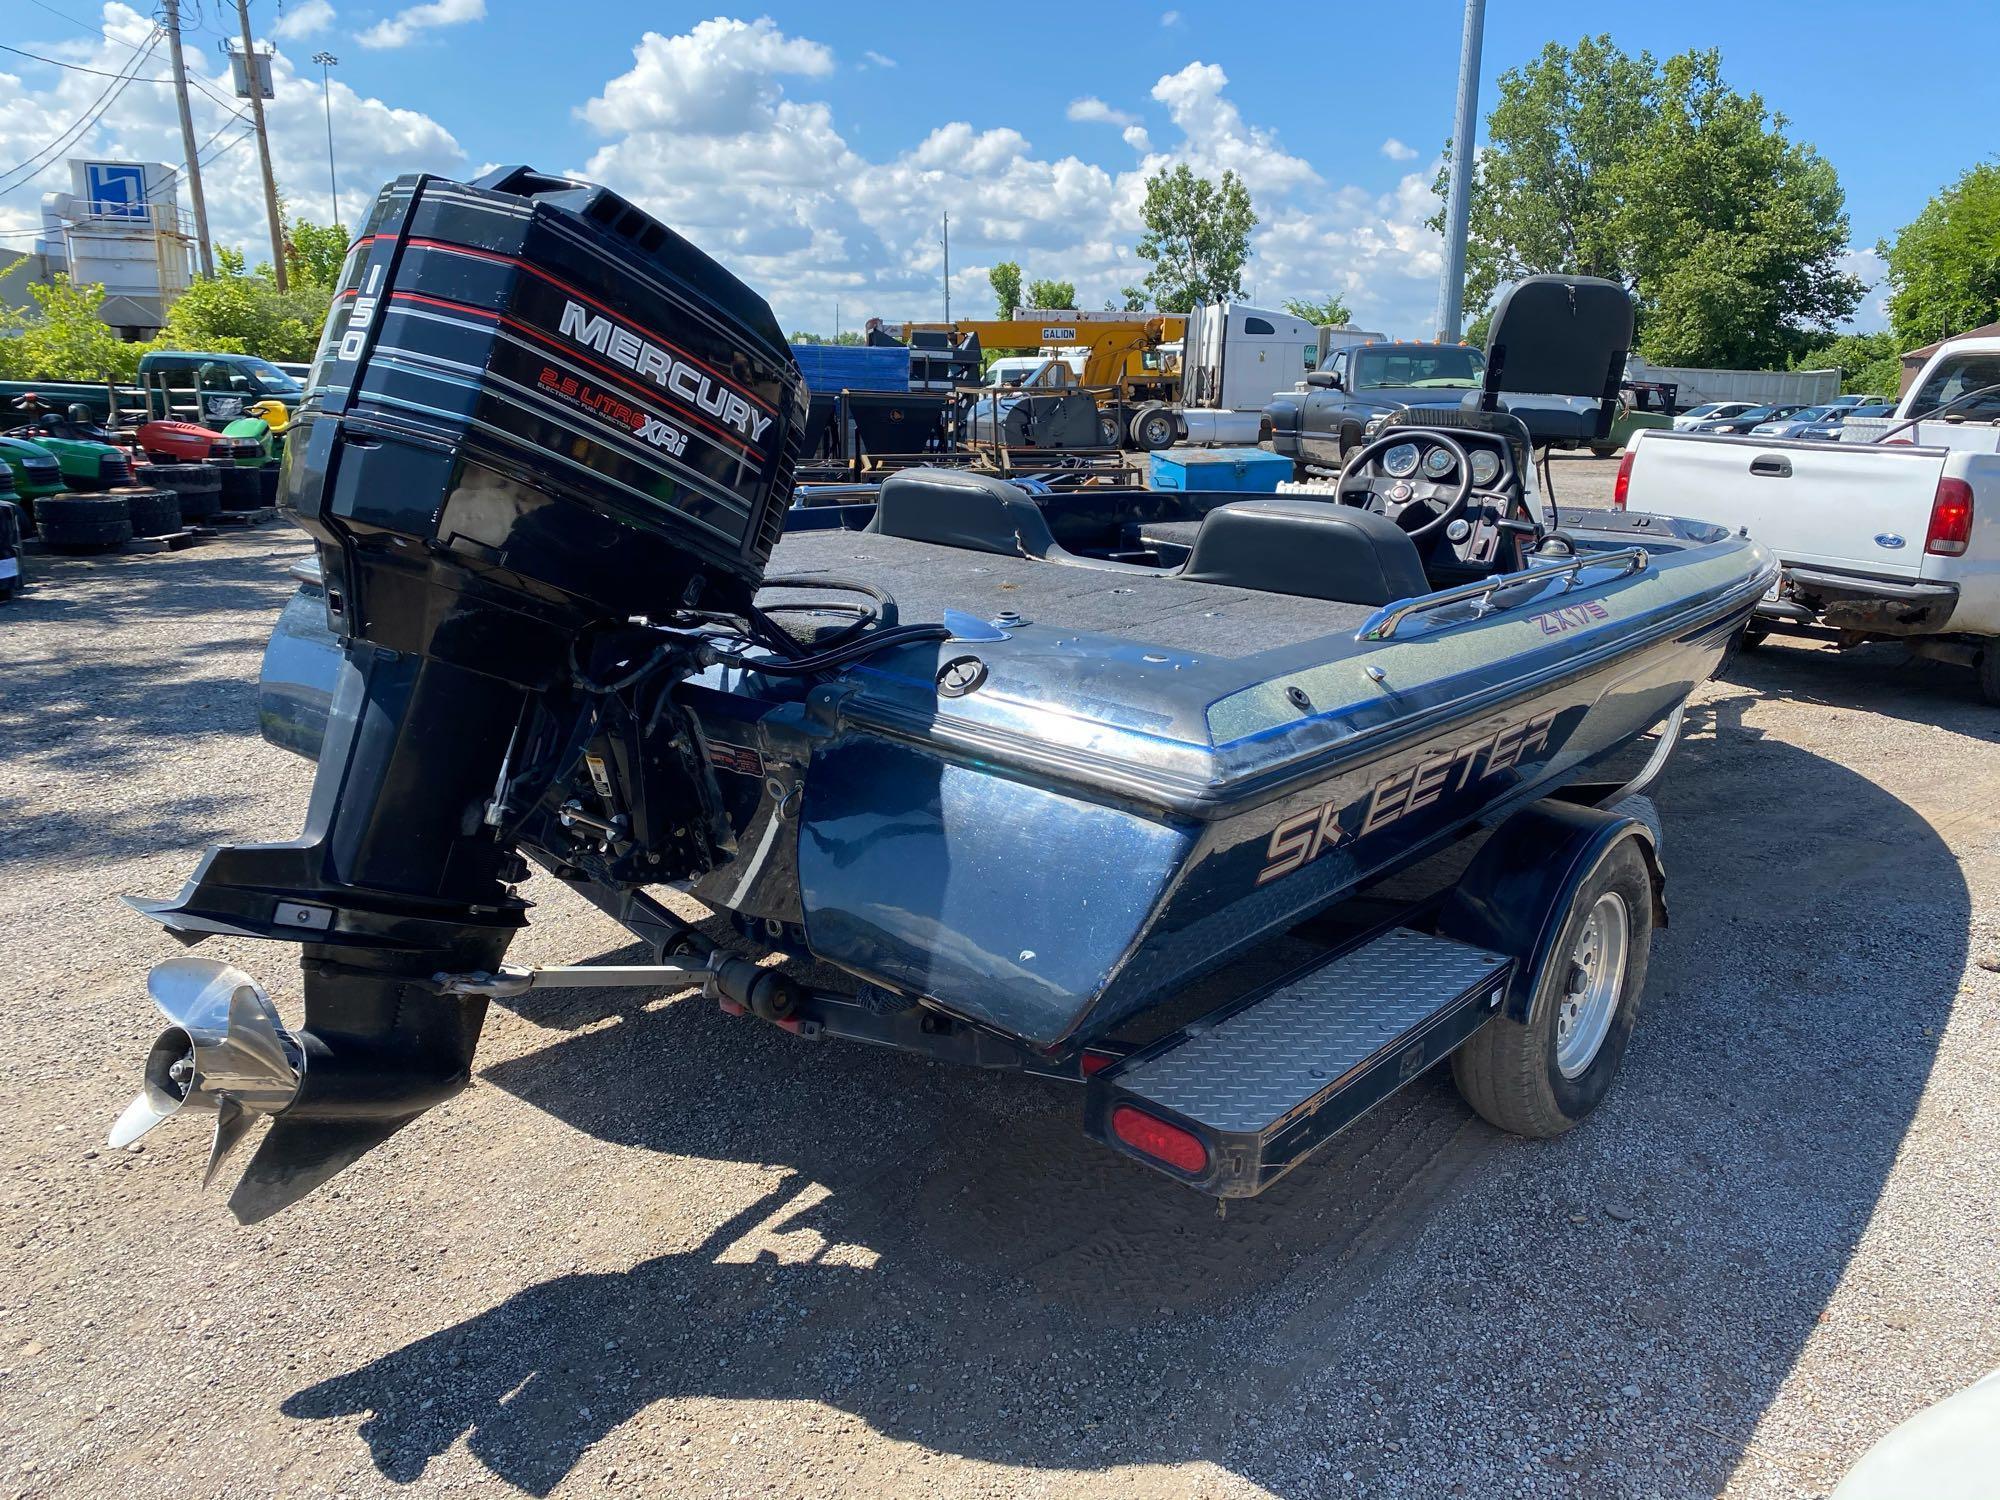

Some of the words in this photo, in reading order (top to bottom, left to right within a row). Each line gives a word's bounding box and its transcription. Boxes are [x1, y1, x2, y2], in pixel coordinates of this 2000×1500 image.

[338, 264, 382, 361] 150
[1043, 329, 1075, 339] GALION
[537, 381, 581, 406] ELECTRONIC
[581, 403, 597, 415] FUEL
[598, 411, 631, 431] INJECTION
[539, 367, 579, 397] 2.5
[633, 413, 688, 457] XRi
[558, 299, 773, 442] MERCURY
